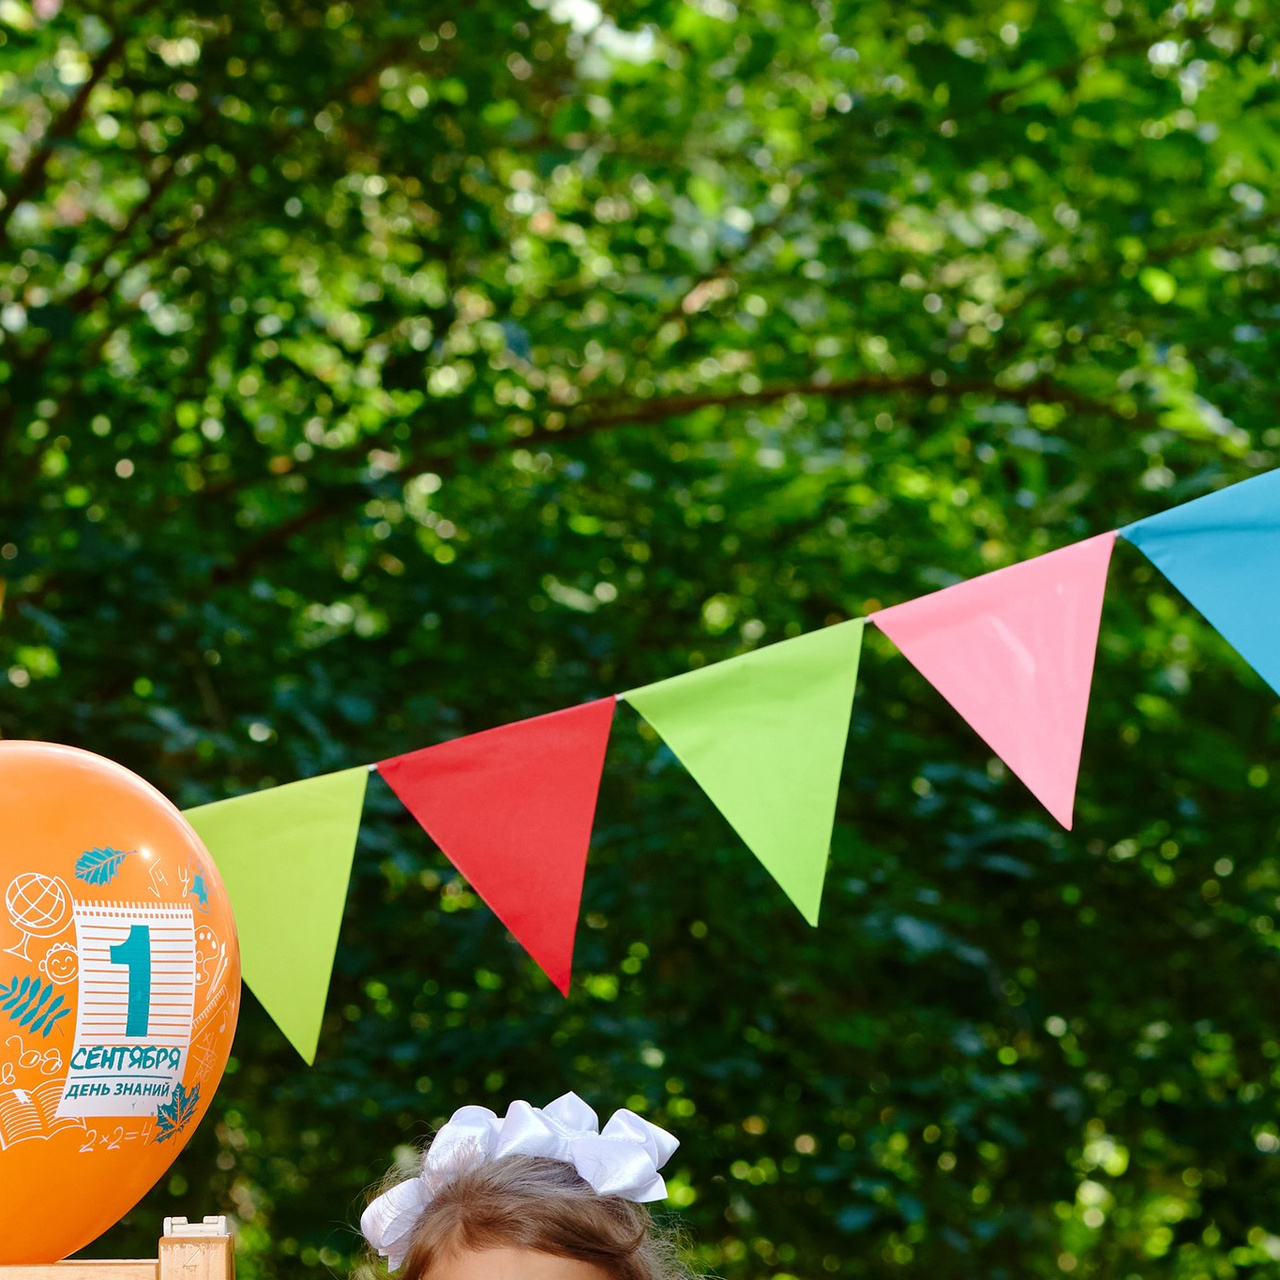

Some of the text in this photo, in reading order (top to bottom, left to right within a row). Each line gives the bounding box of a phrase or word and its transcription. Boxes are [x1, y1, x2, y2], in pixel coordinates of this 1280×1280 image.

[109, 924, 151, 1037] 1
[70, 1044, 181, 1071] СЕНТЯБРЯ
[64, 1081, 171, 1100] ДЕНЬ ЗНАНИЙ
